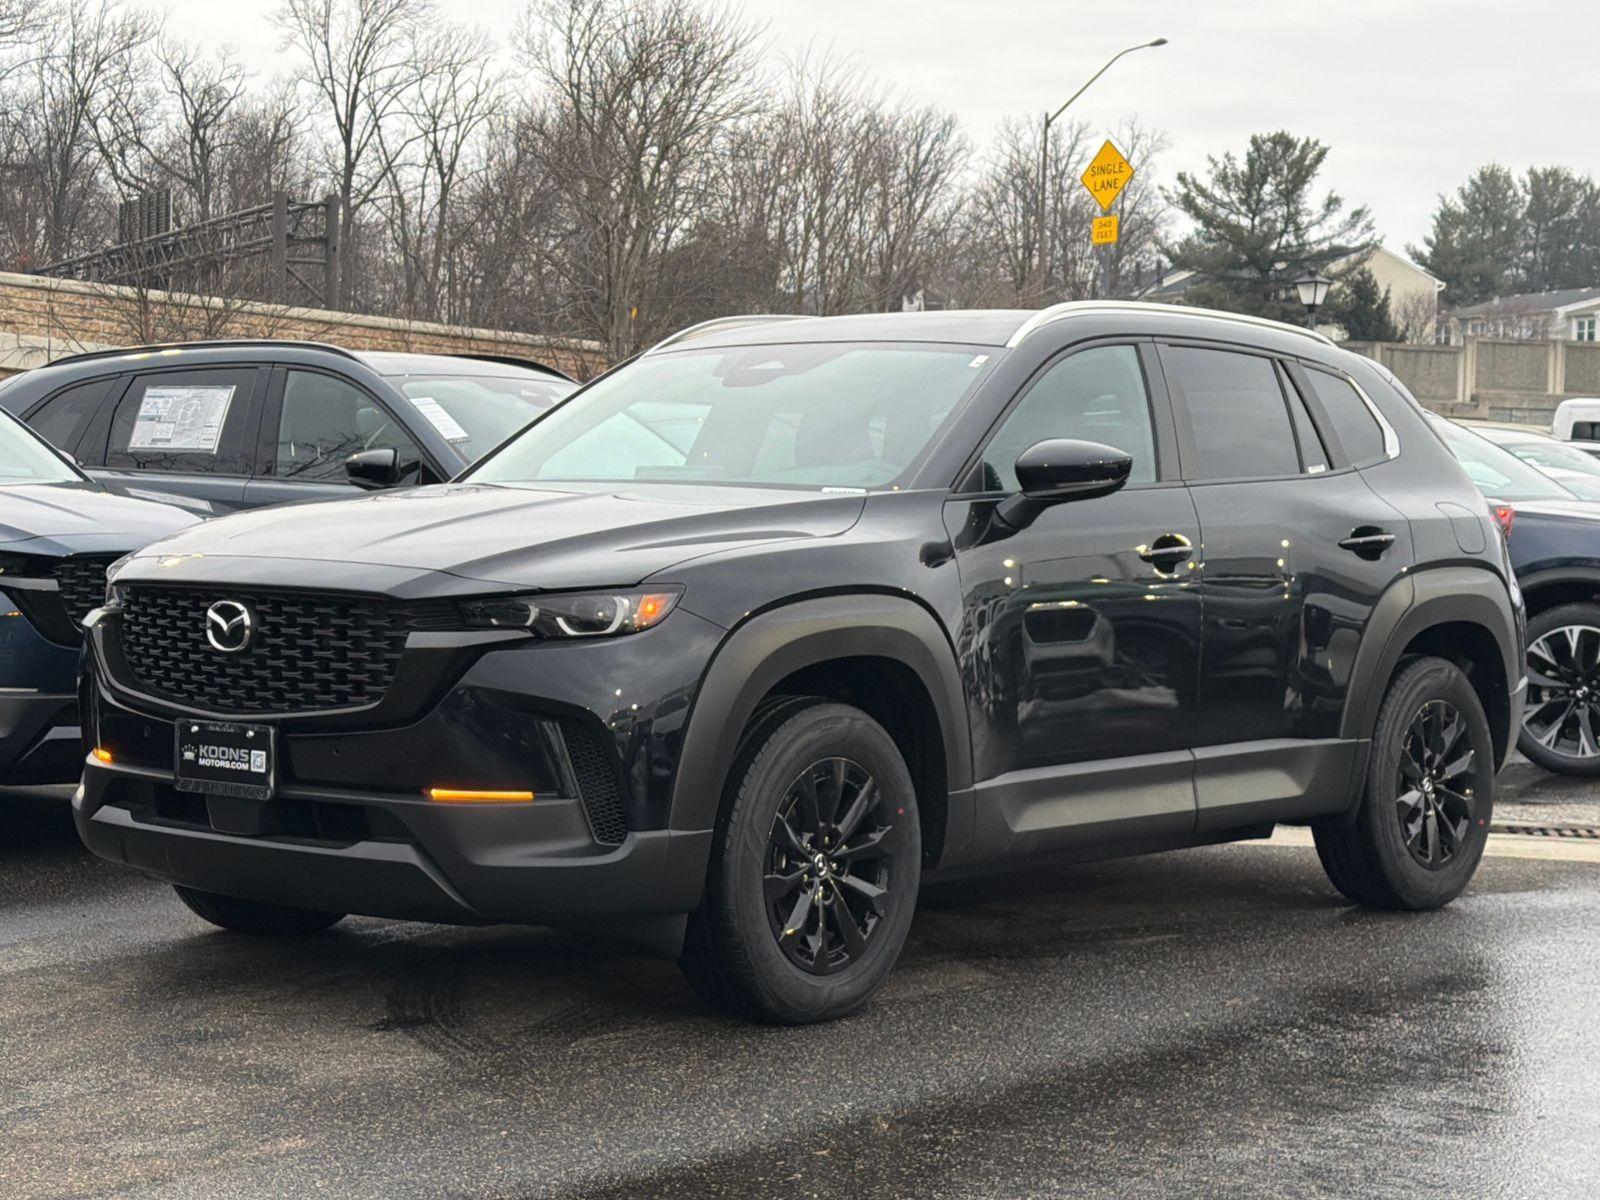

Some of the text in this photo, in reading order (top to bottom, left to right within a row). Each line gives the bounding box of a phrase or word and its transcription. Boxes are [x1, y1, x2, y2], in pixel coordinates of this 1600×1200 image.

[1091, 162, 1124, 177] SINGLE
[1094, 178, 1119, 192] LANE
[199, 744, 249, 762] KOONS
[198, 758, 249, 771] MOTORS.COM
